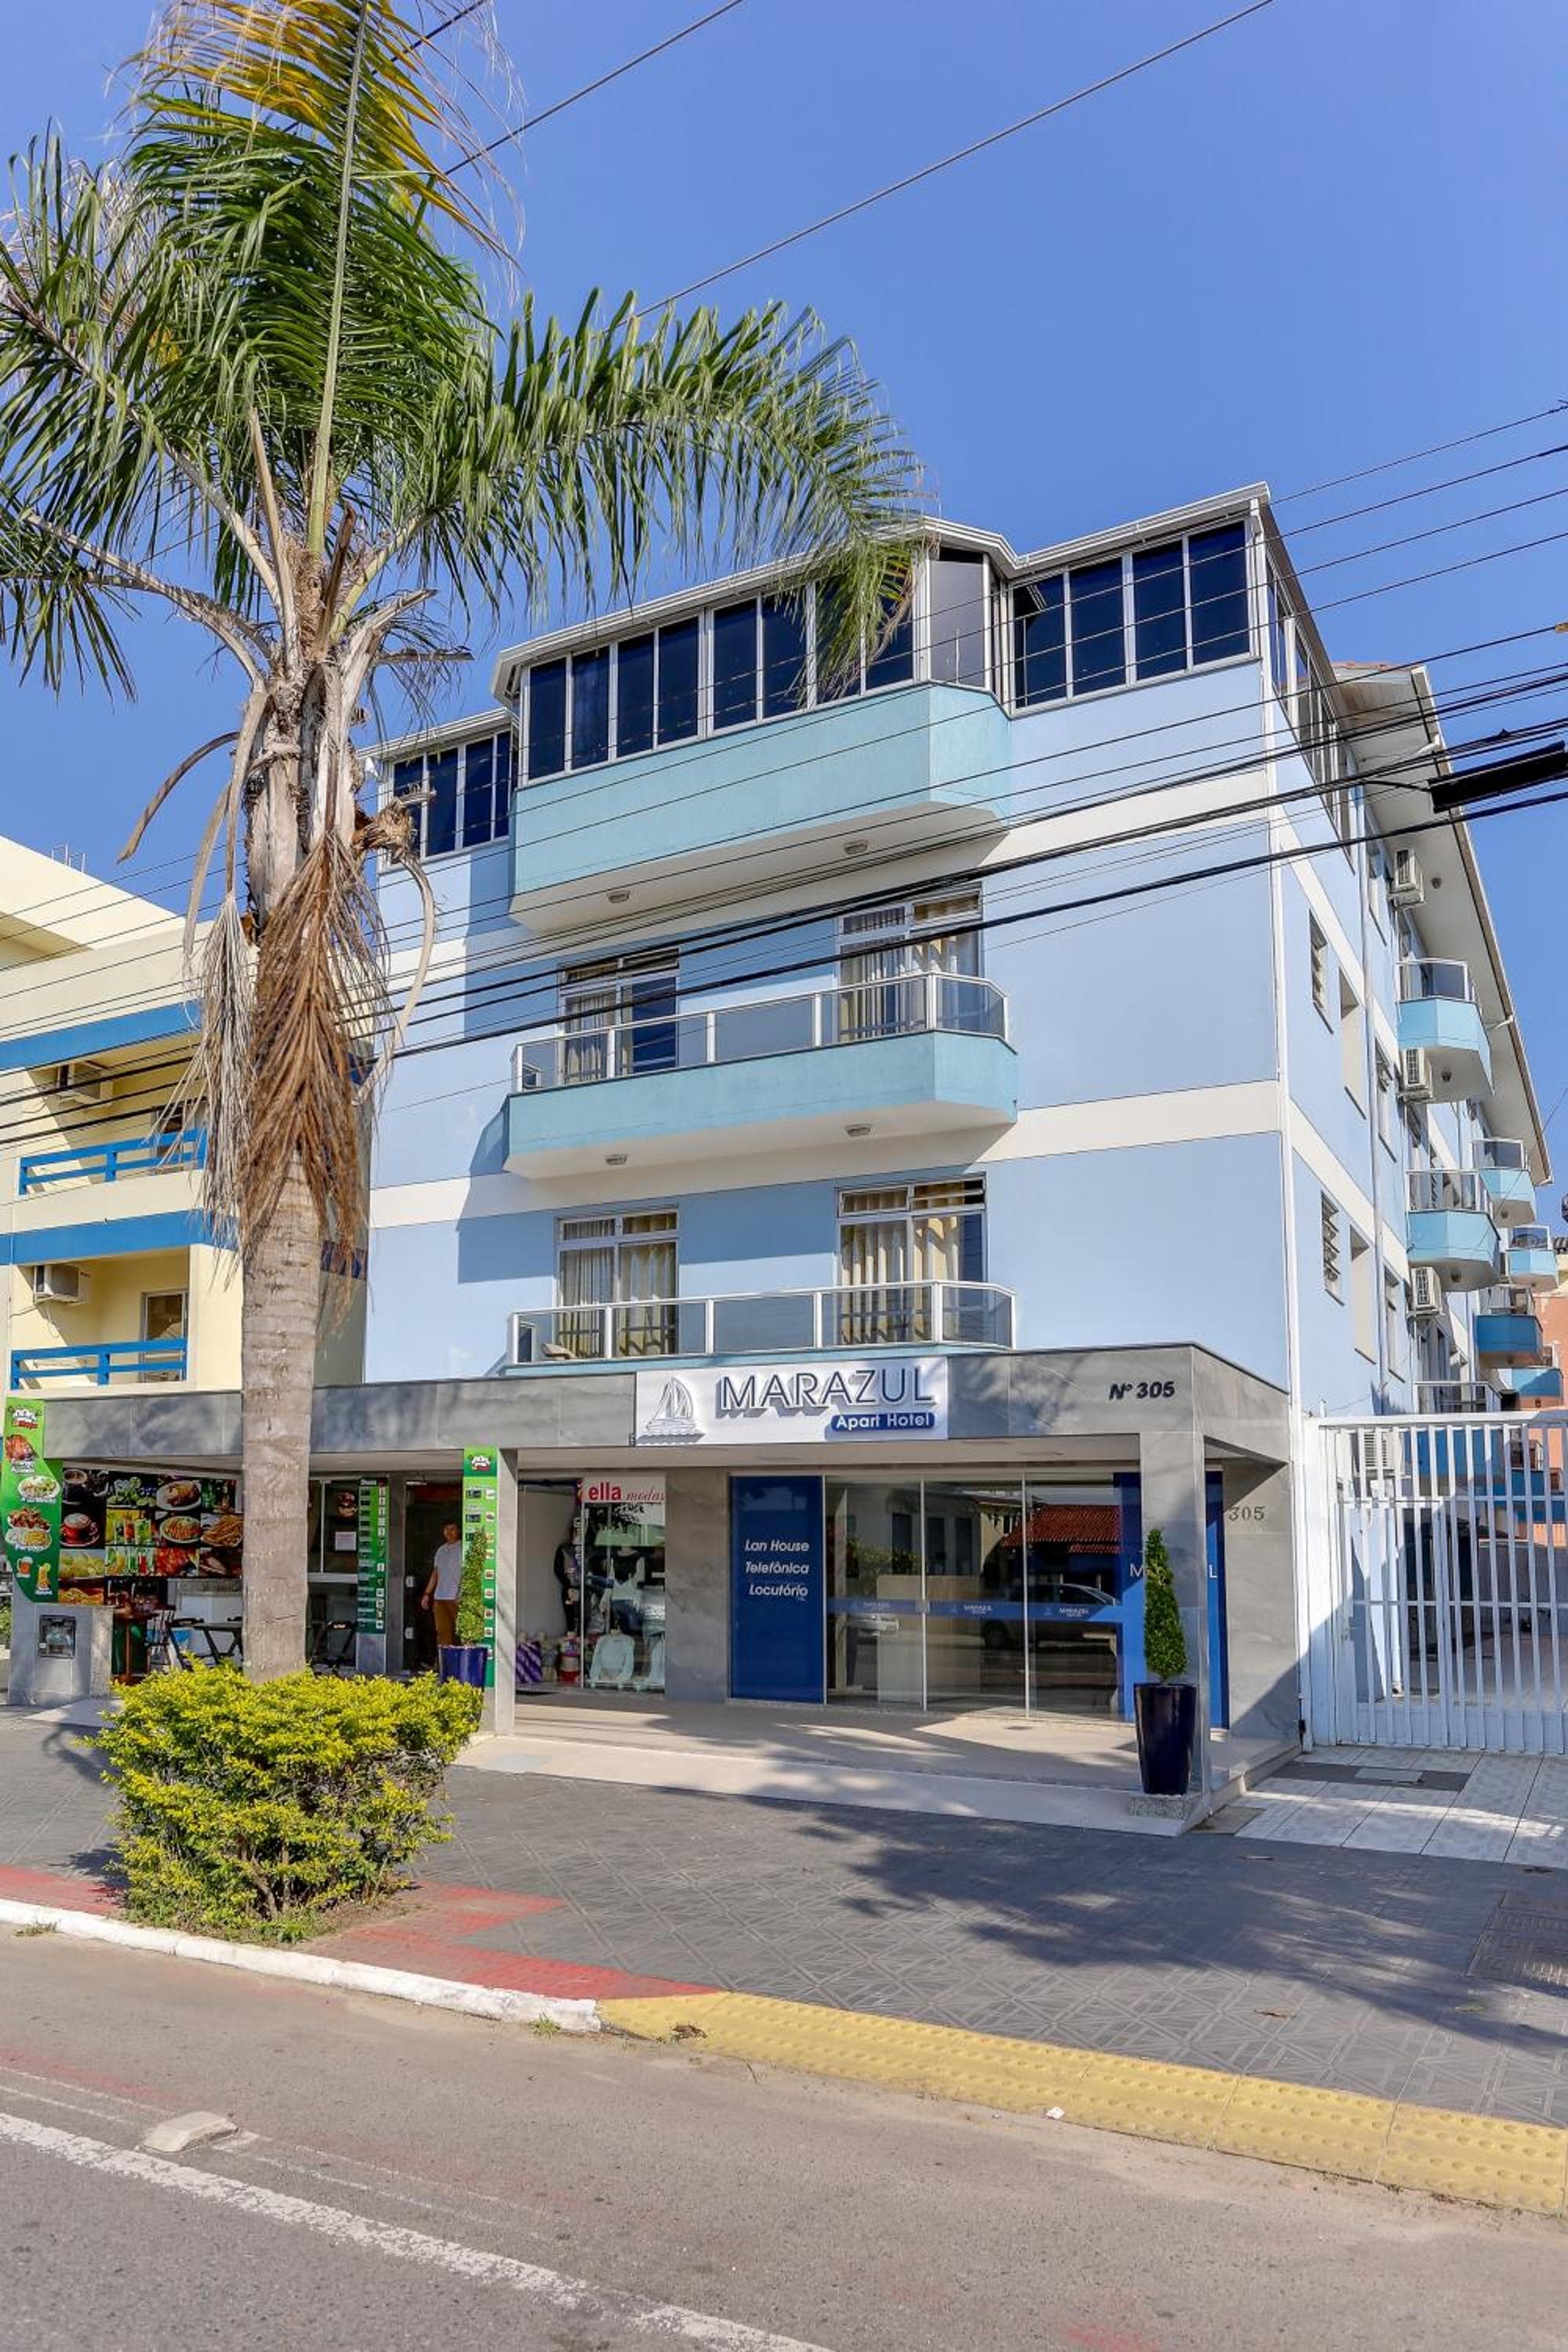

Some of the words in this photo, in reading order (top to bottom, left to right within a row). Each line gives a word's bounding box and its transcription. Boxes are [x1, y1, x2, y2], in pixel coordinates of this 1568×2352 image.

[721, 1367, 935, 1408] MARAZUL
[1137, 1381, 1175, 1399] 305
[836, 1414, 879, 1431] Apart
[887, 1412, 930, 1427] Hotel
[588, 1481, 622, 1501] ella
[1229, 1506, 1265, 1522] 305
[744, 1539, 768, 1552] Lan
[770, 1539, 810, 1552] House
